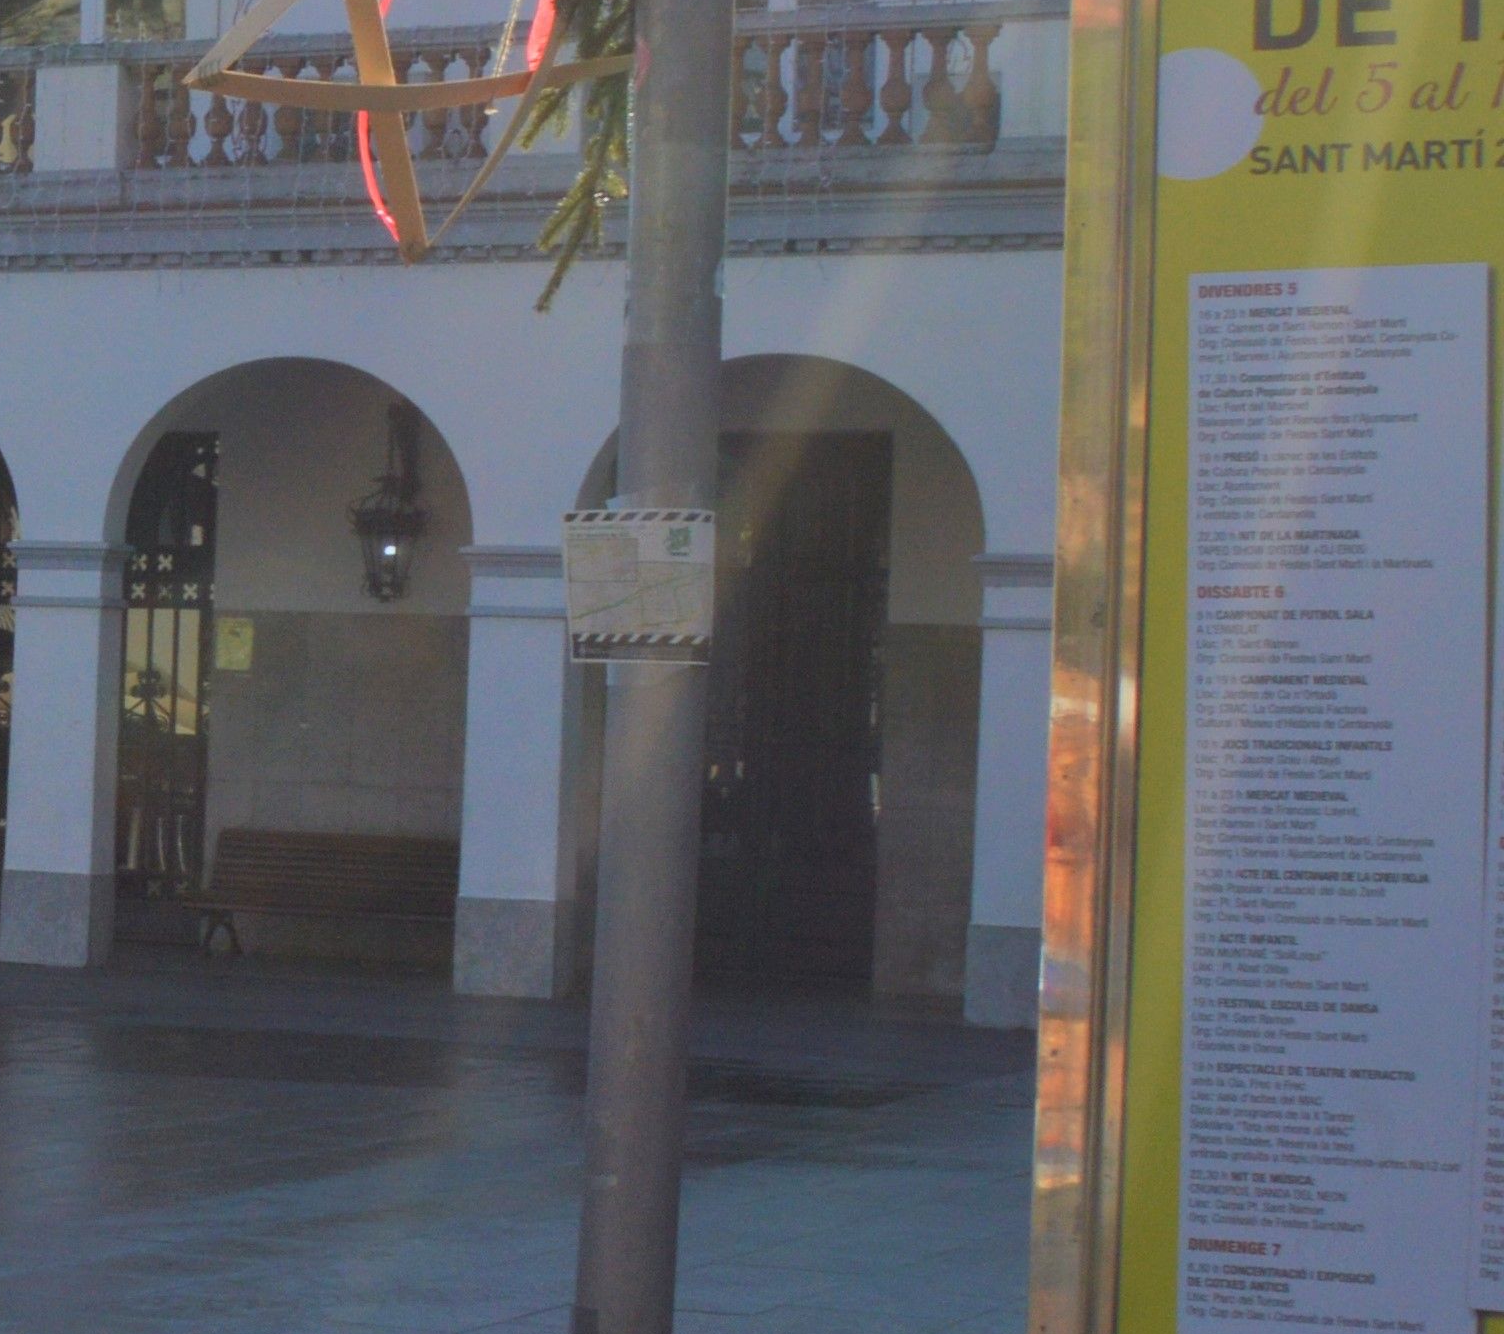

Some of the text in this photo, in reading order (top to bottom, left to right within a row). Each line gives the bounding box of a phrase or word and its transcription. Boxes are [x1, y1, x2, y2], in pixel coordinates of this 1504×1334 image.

[1254, 67, 1338, 117] del
[1356, 62, 1400, 113] 5
[1410, 62, 1472, 112] al
[1249, 143, 1352, 176] SANT
[1362, 128, 1486, 172] MARTÍ
[1198, 281, 1297, 297] DIVENDRES 5
[1197, 586, 1284, 599] DISSABTE 6
[1188, 1237, 1280, 1256] DIUMENGE 7
